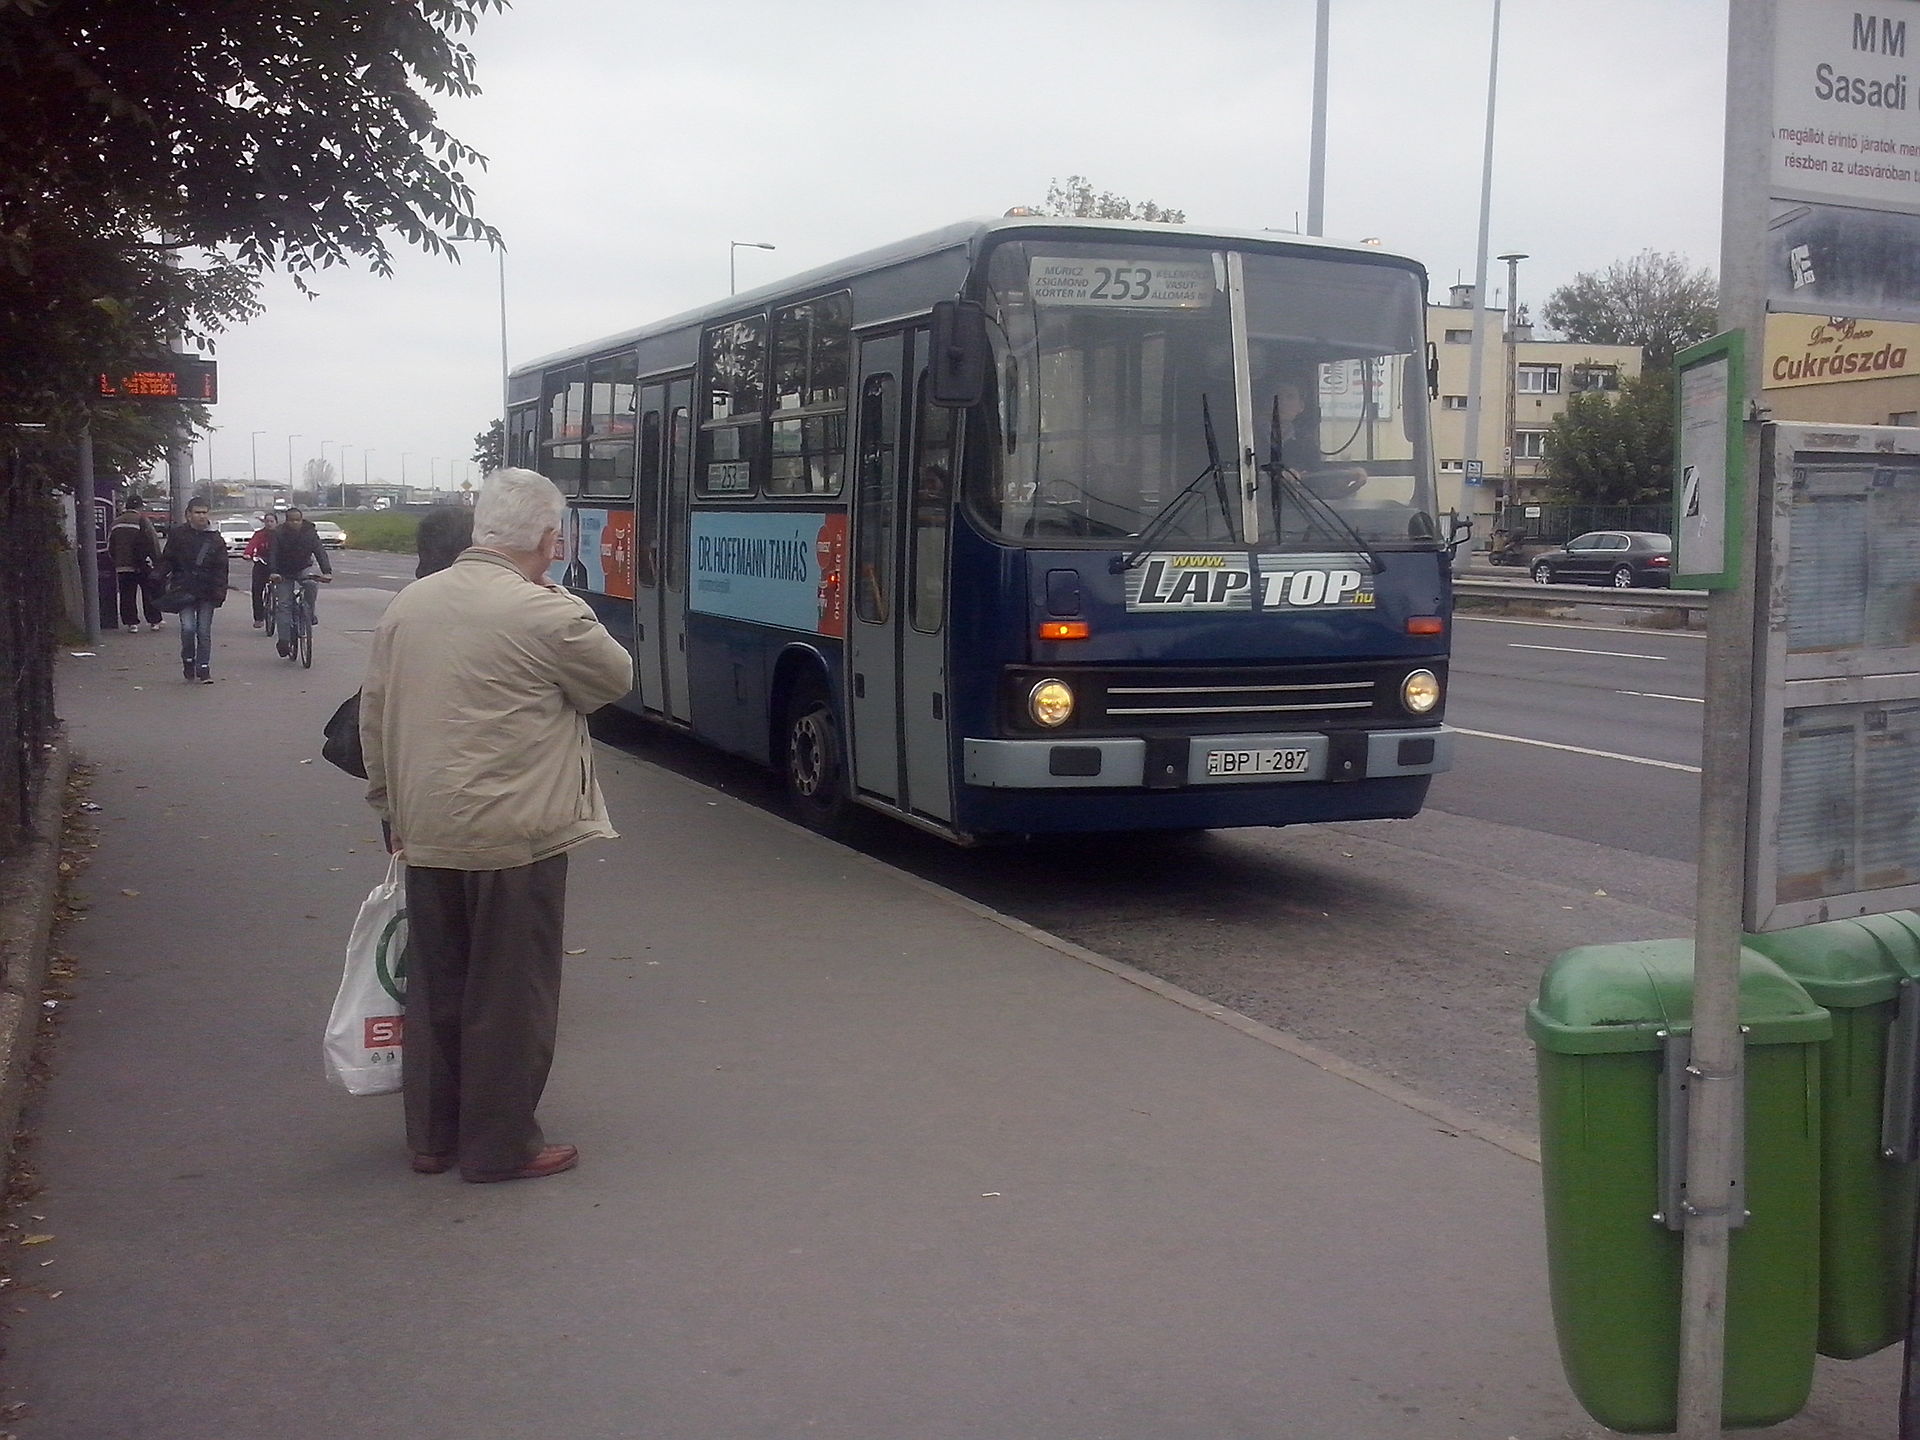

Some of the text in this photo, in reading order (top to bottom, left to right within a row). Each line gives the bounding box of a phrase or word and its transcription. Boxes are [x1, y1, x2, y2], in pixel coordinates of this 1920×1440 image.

[1815, 62, 1906, 110] Sasadi
[1784, 152, 1828, 172] részben
[1831, 161, 1844, 174] az
[1035, 276, 1089, 288] ZSIGMOND
[1090, 266, 1152, 300] 253
[1773, 344, 1908, 381] Cukrászda
[714, 536, 767, 579] HOFFMANN
[769, 529, 808, 583] TAMÁS
[1172, 555, 1226, 568] www.
[1223, 750, 1307, 772] BPI-287
